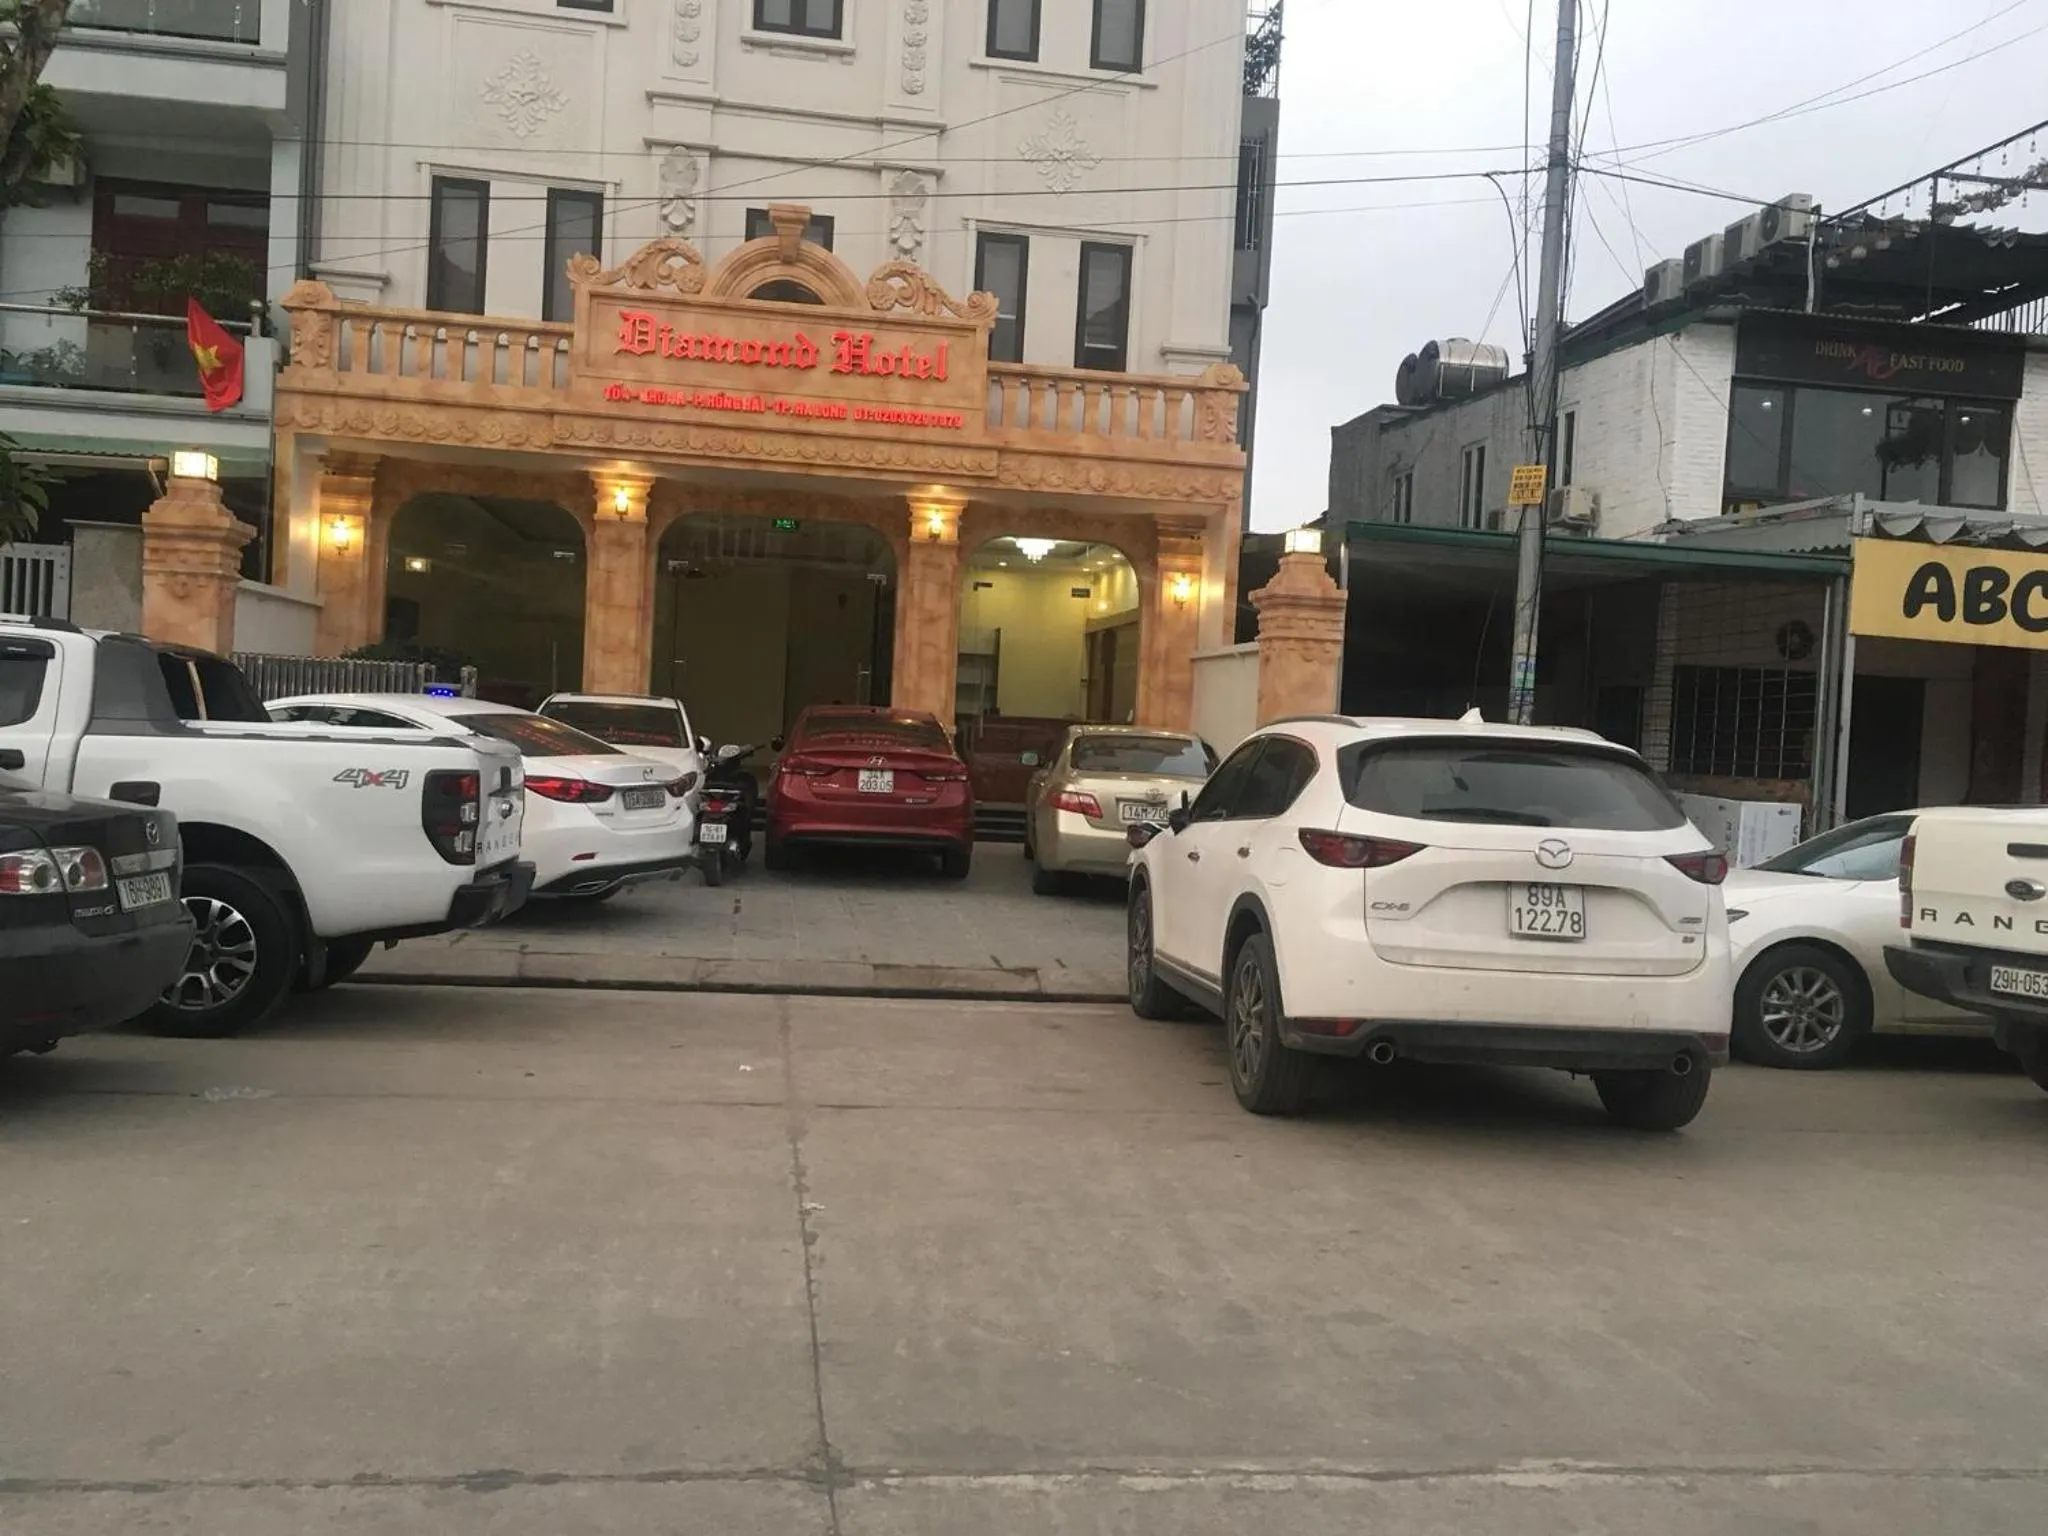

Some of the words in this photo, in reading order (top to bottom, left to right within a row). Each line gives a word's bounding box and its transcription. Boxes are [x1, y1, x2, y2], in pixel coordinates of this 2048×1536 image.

[613, 309, 818, 370] Diamond
[830, 329, 949, 383] Hotel
[1815, 338, 1857, 359] DRINK
[1929, 357, 1966, 374] FOOD
[1528, 885, 1566, 908] 89A
[1515, 907, 1582, 934] 122.78
